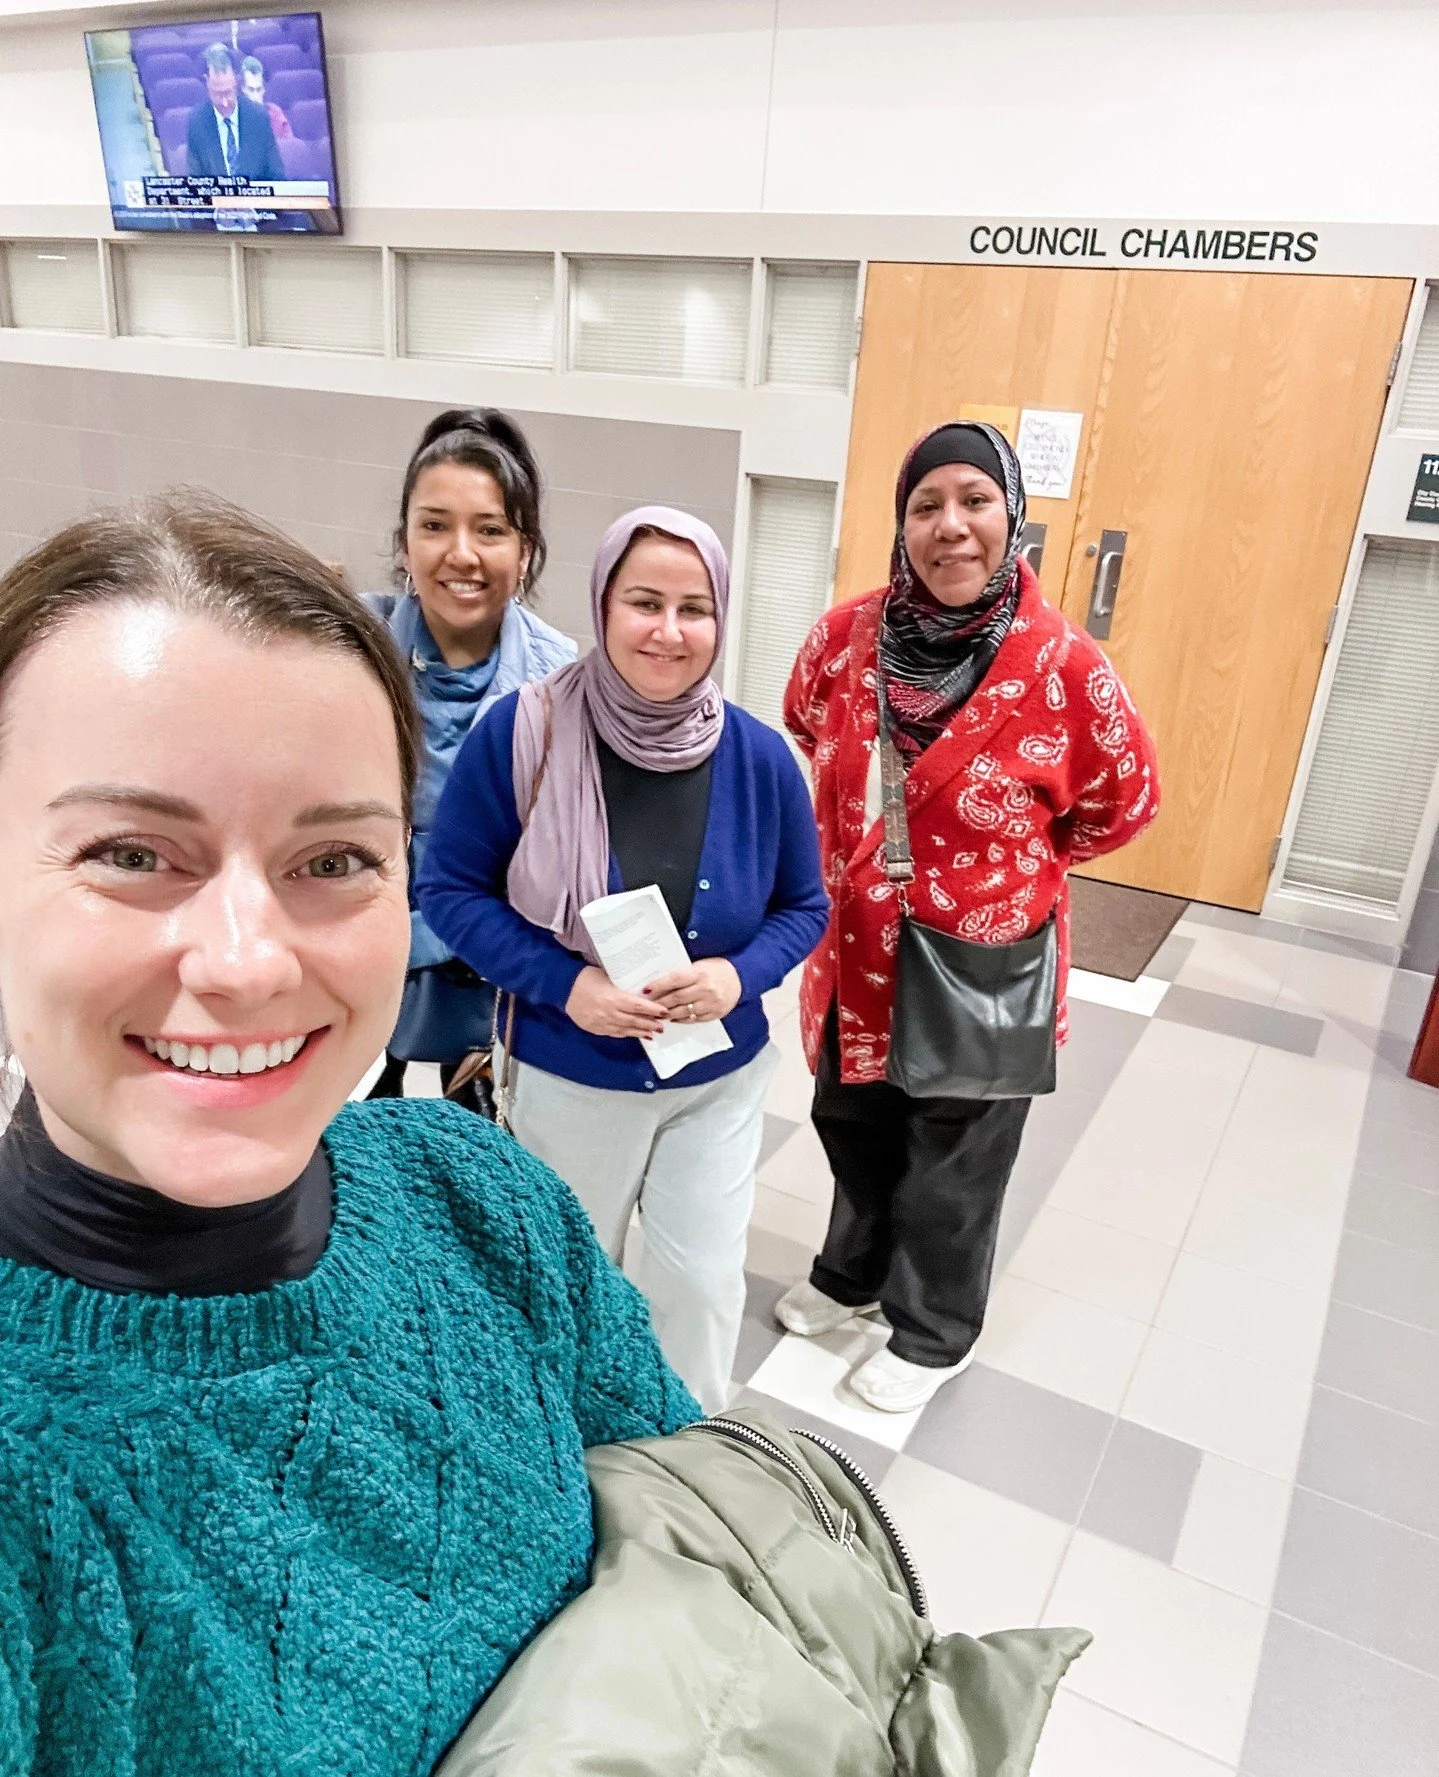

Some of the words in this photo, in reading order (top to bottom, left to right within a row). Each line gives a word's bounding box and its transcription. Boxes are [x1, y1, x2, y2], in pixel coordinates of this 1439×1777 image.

[187, 176, 215, 187] County
[218, 176, 247, 186] Health
[197, 186, 222, 196] which
[225, 187, 235, 196] is
[238, 187, 271, 196] located
[970, 225, 1106, 257] COUNCIL
[1120, 228, 1319, 263] CHAMBERS
